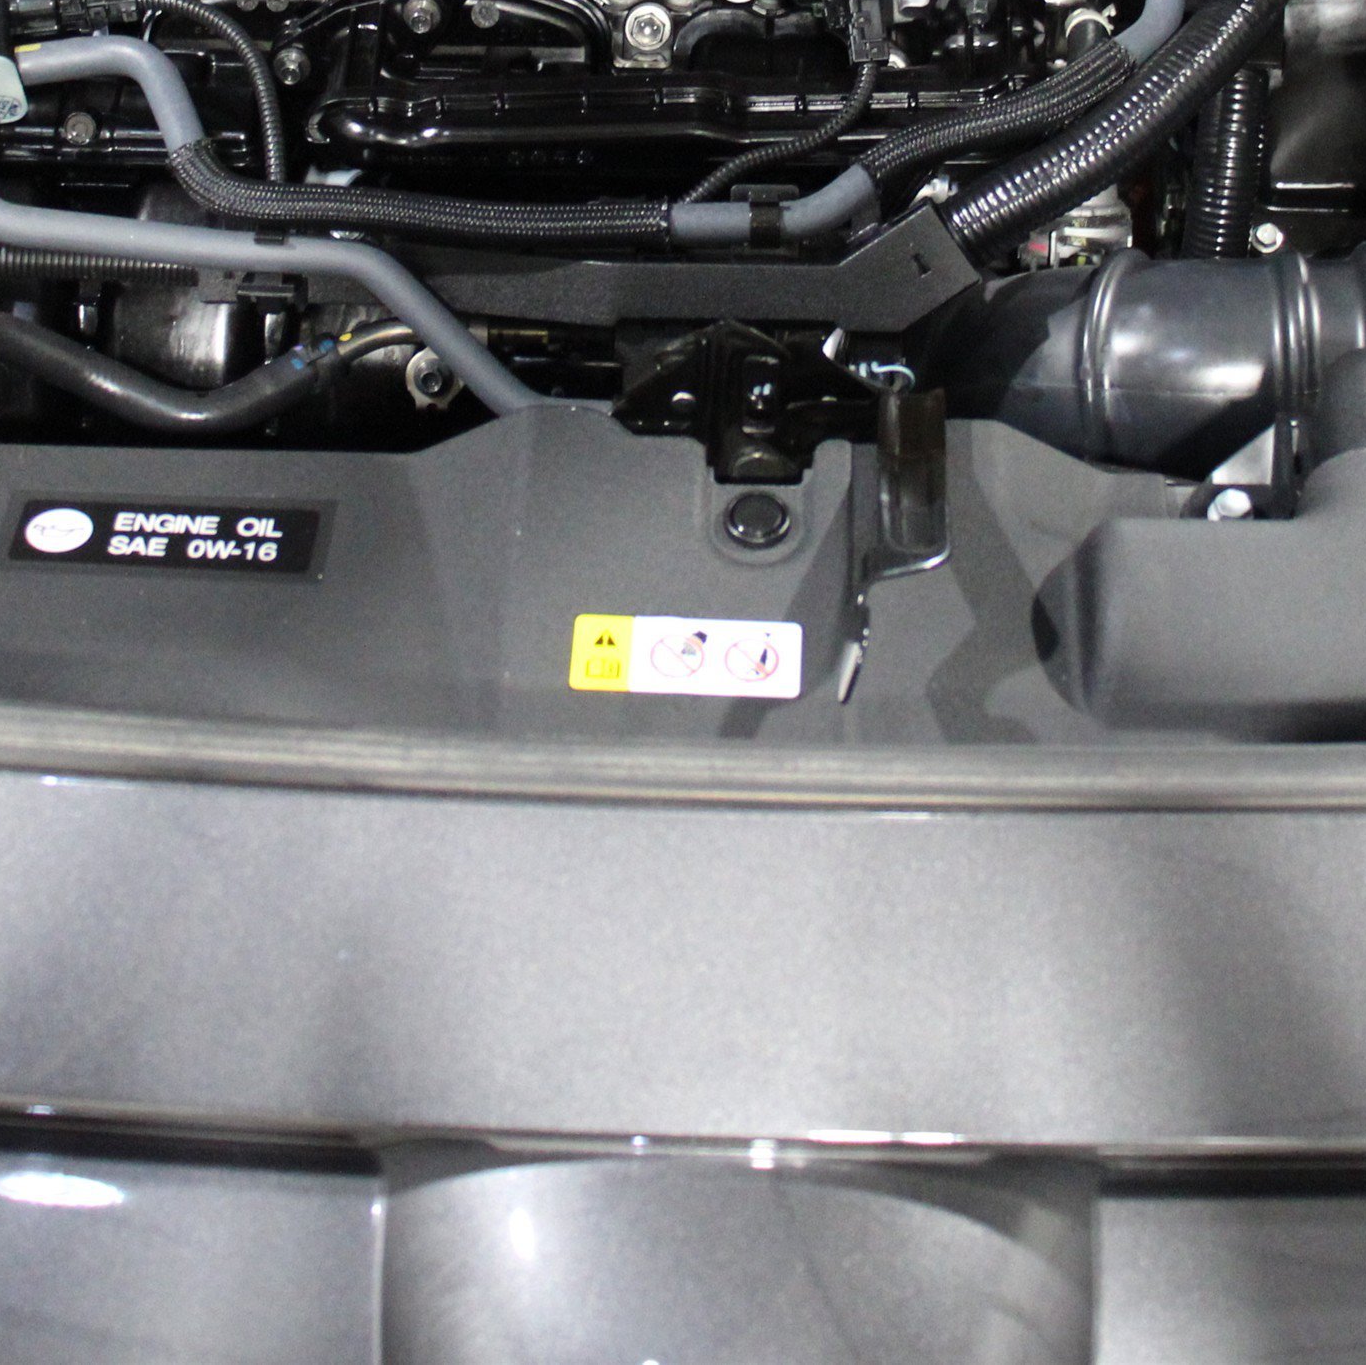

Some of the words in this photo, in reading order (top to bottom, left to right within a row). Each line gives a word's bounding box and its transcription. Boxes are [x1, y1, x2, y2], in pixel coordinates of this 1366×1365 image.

[113, 511, 221, 536] ENGINE
[236, 517, 284, 538] OIL
[107, 535, 169, 557] SAE
[186, 539, 278, 563] 0W-16
